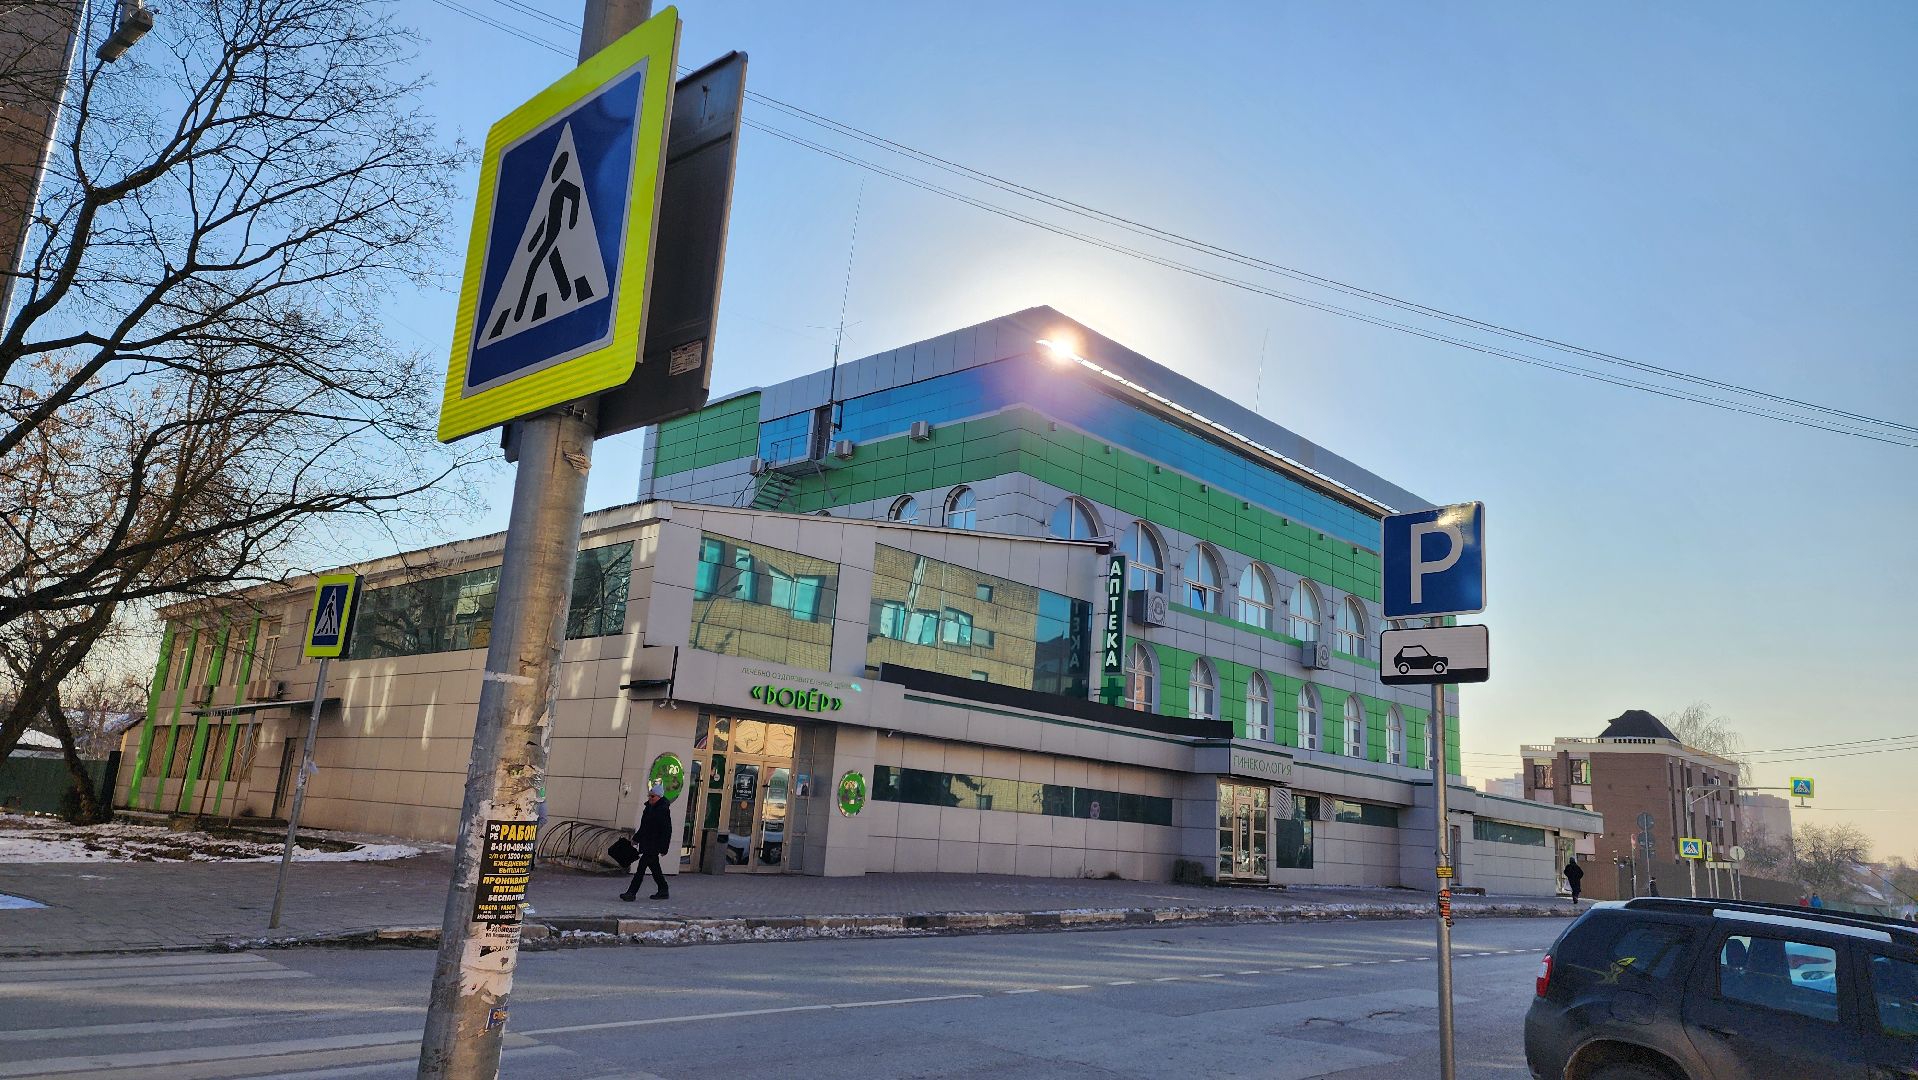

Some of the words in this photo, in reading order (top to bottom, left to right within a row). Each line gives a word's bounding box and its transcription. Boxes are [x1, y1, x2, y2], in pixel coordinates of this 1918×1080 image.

[1410, 520, 1464, 604] P
[1105, 560, 1122, 667] АПТЕКА
[1233, 755, 1292, 776] ГИНЕКОЛОГИЯ
